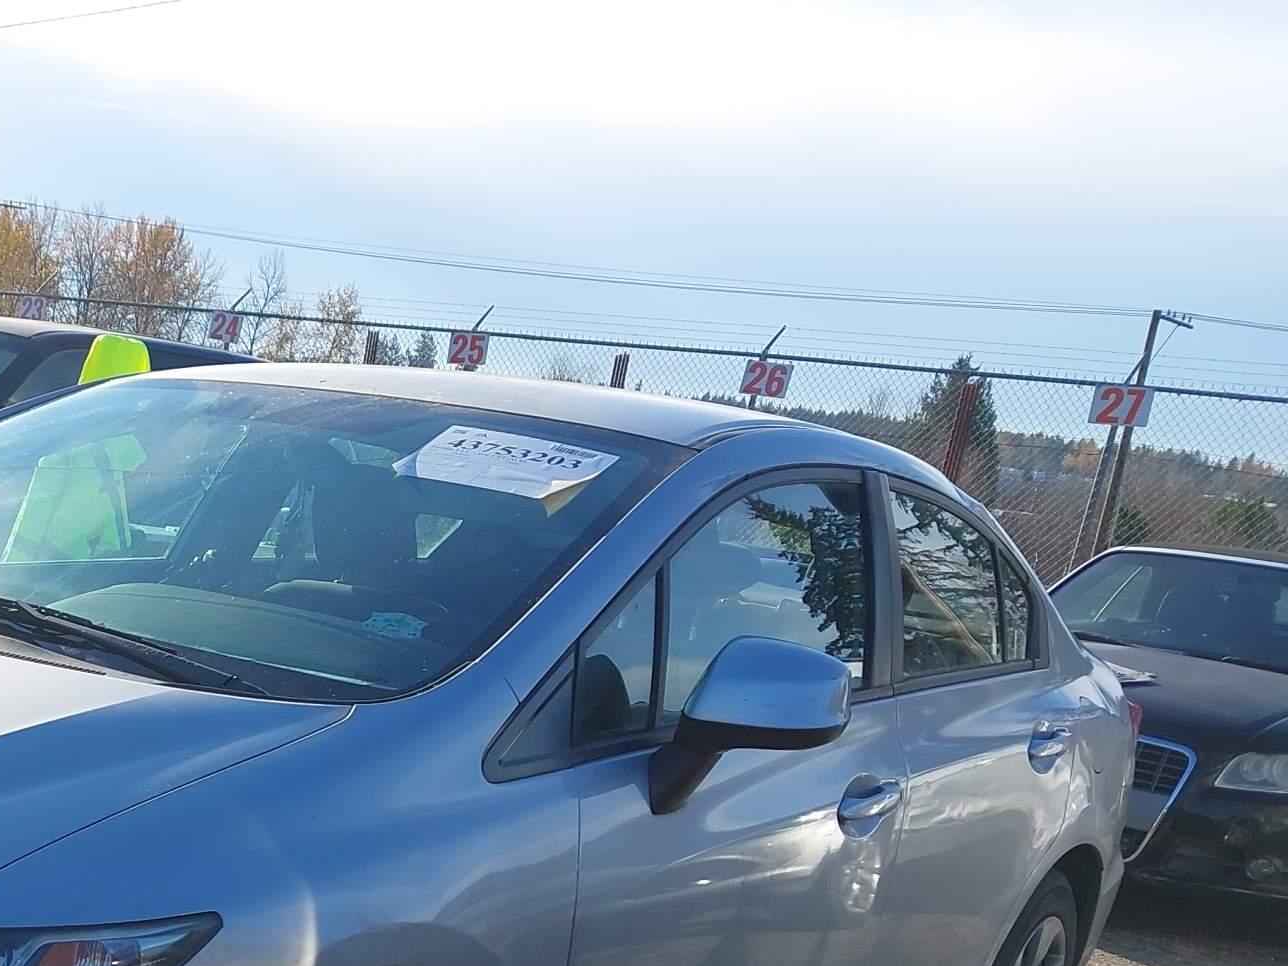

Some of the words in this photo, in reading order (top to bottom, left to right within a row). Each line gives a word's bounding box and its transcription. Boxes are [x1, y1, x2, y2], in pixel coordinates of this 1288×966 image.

[21, 297, 44, 319] 23
[212, 311, 241, 343] 24
[449, 334, 486, 364] 25
[743, 362, 788, 396] 26
[1095, 387, 1146, 424] 27
[448, 437, 583, 470] 43753203
